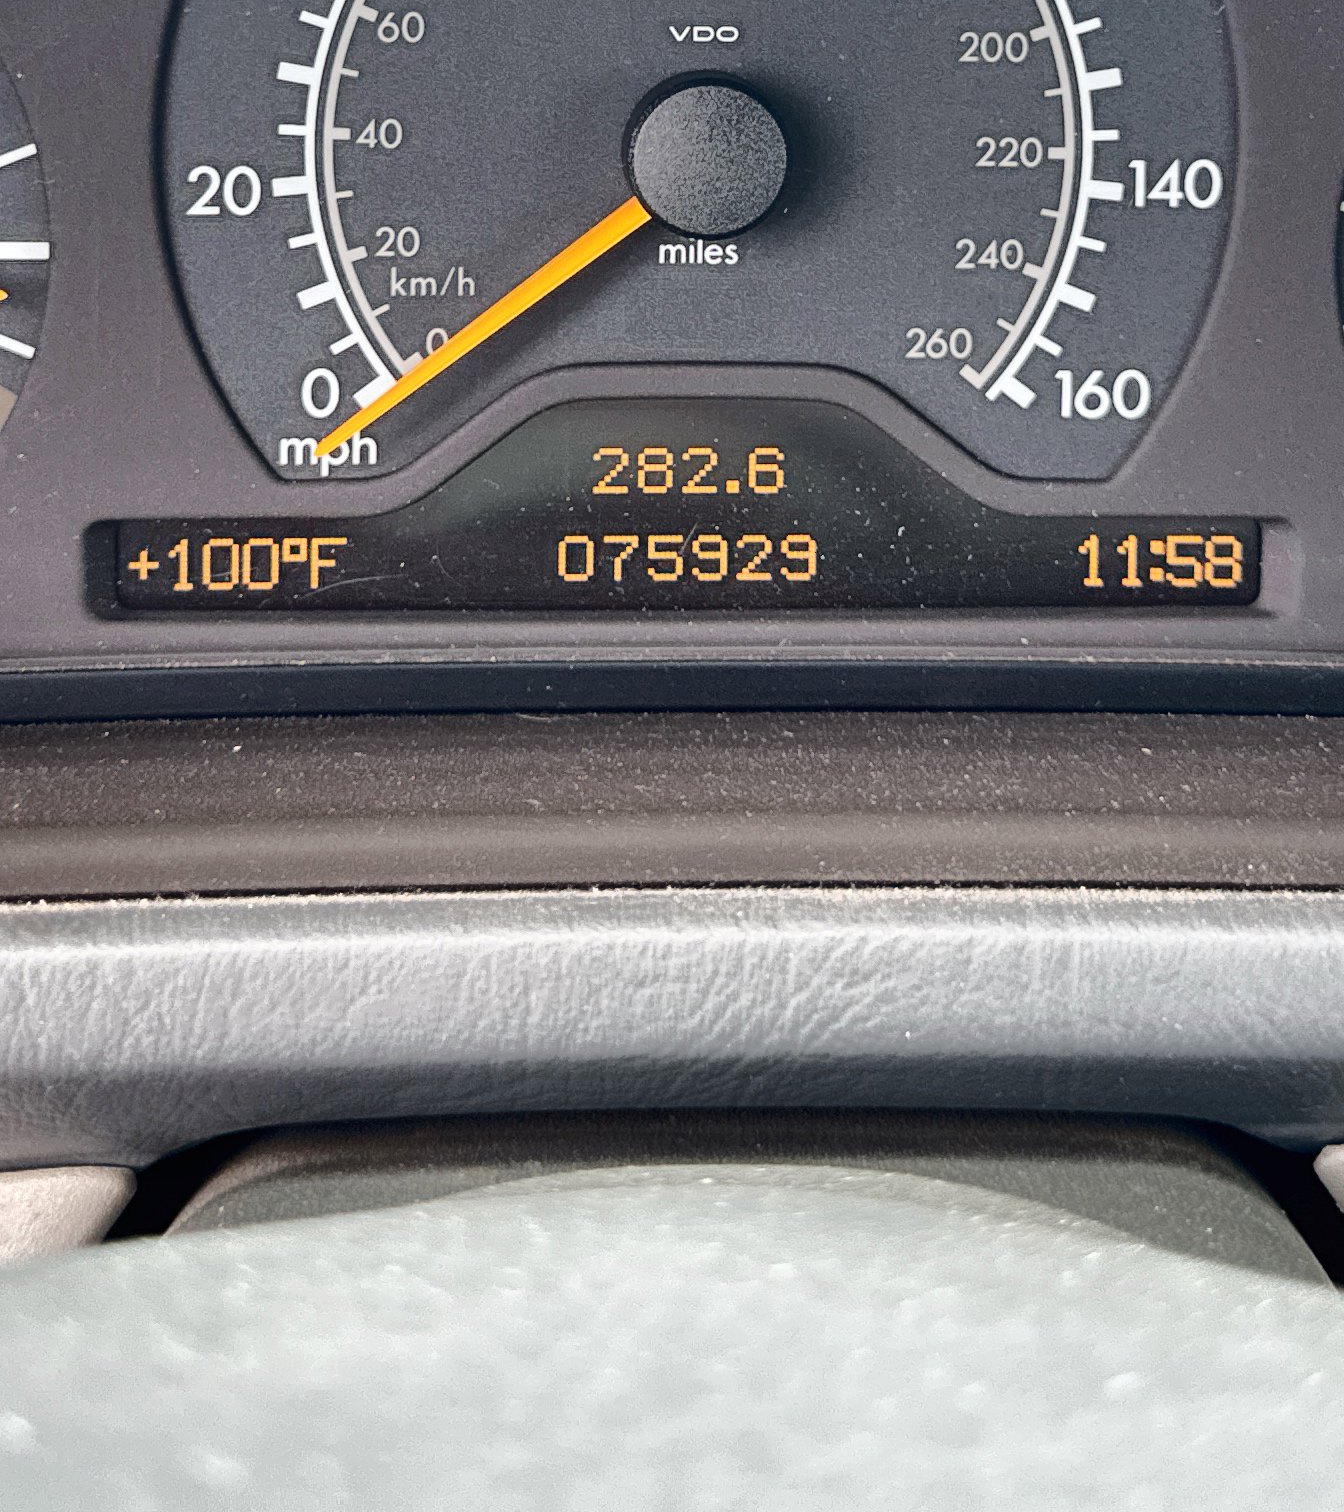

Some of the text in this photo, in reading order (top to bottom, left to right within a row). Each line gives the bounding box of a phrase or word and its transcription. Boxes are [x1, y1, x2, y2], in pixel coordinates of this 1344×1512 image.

[377, 12, 425, 44] 60
[668, 25, 739, 43] VDO
[958, 31, 1029, 63] 200
[355, 118, 403, 150] 40
[975, 136, 1043, 169] 220
[185, 165, 262, 216] 20
[1128, 158, 1223, 209] 140
[374, 226, 421, 258] 20
[658, 239, 739, 266] miles
[954, 238, 1024, 270] 240
[390, 266, 476, 297] km/h
[904, 327, 973, 360] 260
[301, 367, 340, 419] 0
[1054, 369, 1151, 420] 160
[276, 430, 378, 478] mph
[592, 447, 788, 495] 282.6
[557, 533, 819, 582] 075929
[1077, 533, 1243, 589] 11:58
